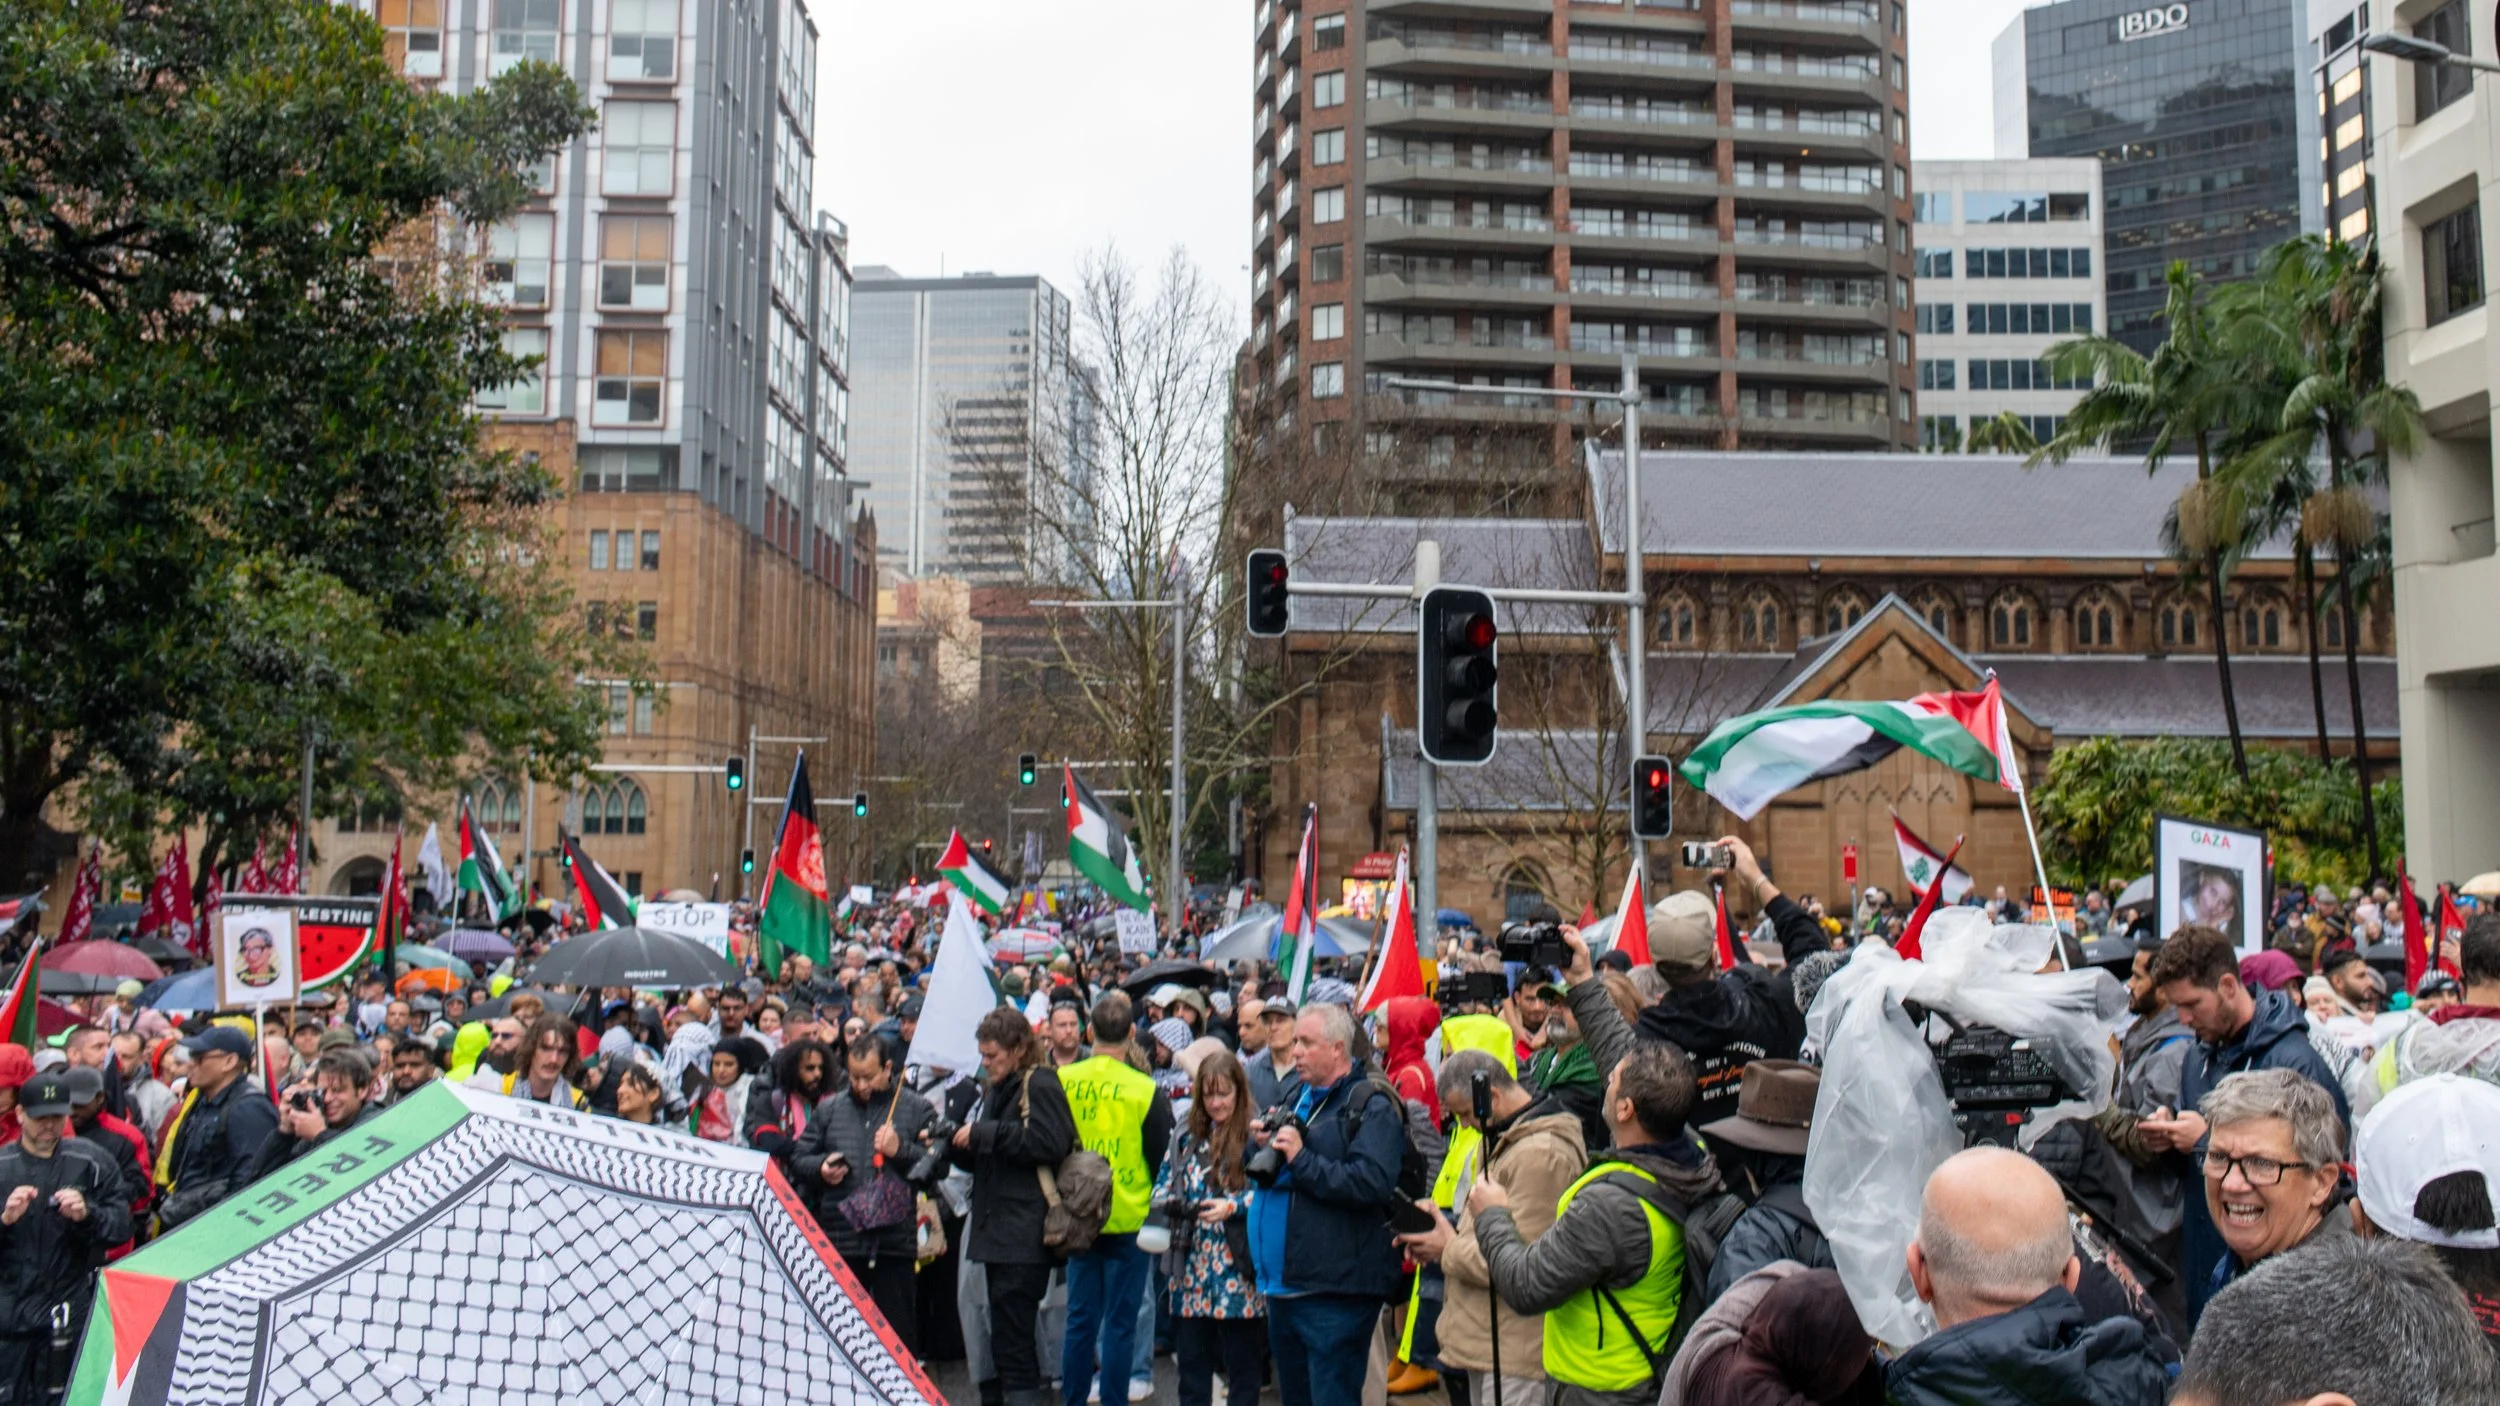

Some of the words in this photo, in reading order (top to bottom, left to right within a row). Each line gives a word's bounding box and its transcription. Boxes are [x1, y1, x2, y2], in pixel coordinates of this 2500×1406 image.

[2120, 2, 2188, 38] BDO
[2191, 830, 2231, 849] GAZA
[298, 907, 373, 924] LESTINE
[654, 908, 715, 927] STOP
[1065, 1079, 1125, 1101] PEACE
[516, 1103, 579, 1128] BE
[1082, 1105, 1097, 1121] IS
[592, 1119, 718, 1158] WILL
[235, 1135, 397, 1227] FREE!
